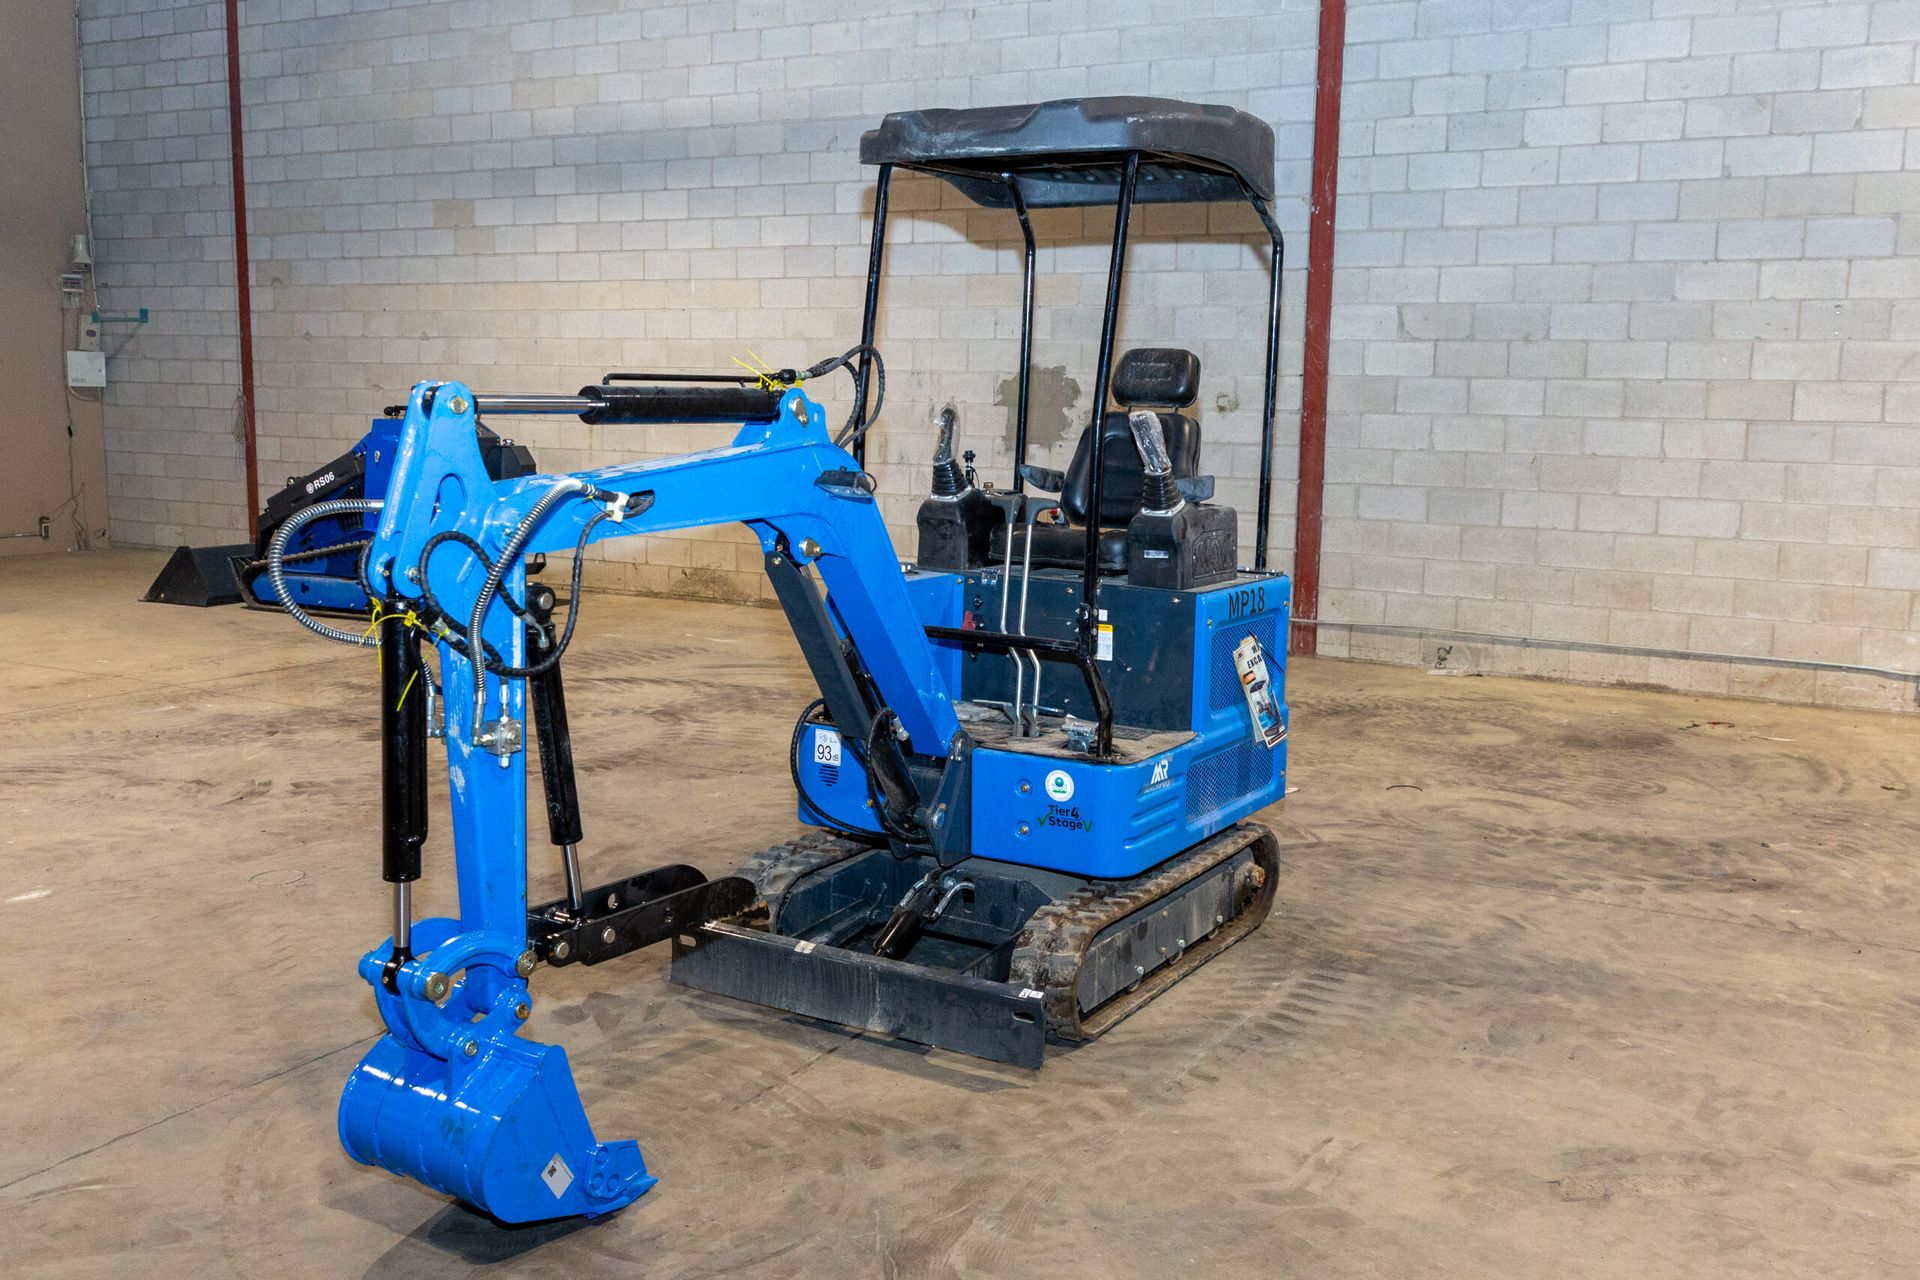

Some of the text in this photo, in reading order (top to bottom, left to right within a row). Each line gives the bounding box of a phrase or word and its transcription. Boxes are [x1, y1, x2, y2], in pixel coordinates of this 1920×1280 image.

[313, 472, 335, 490] RS06
[1228, 586, 1265, 619] MP18
[817, 743, 832, 761] 93
[1048, 815, 1083, 831] Stage
